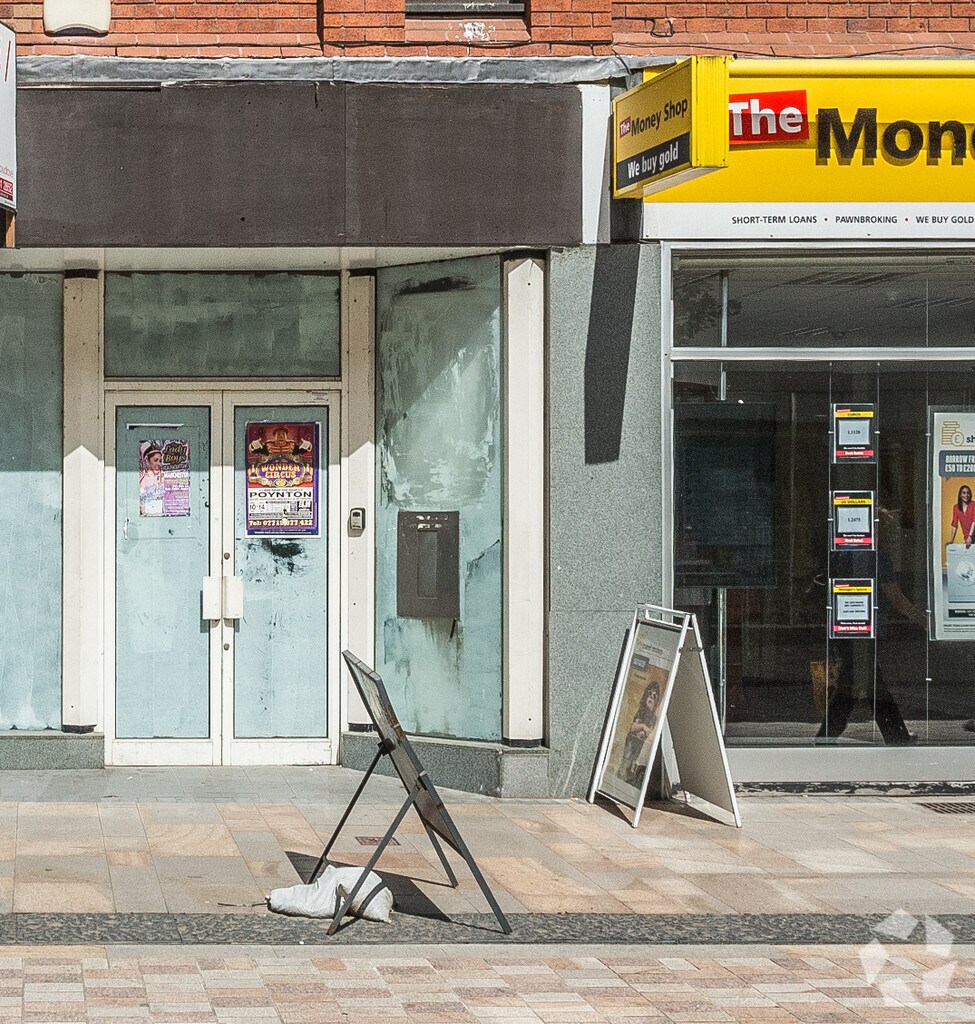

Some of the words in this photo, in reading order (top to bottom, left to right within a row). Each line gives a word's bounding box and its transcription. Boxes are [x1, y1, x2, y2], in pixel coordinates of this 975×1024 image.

[620, 119, 631, 136] The
[631, 111, 662, 136] Money
[663, 98, 688, 121] Shop
[728, 98, 804, 136] The
[817, 107, 975, 162] Mon
[627, 160, 640, 179] We
[641, 151, 658, 174] buy
[659, 141, 679, 167] gold
[731, 216, 787, 224] SHORT-TERM
[789, 215, 818, 224] LOANS
[835, 215, 898, 224] PAWNBROKING
[915, 215, 930, 224] WE
[931, 215, 948, 224] BUY
[950, 215, 974, 224] GOLD
[261, 463, 301, 472] WONDER
[265, 471, 297, 479] CIRCUS
